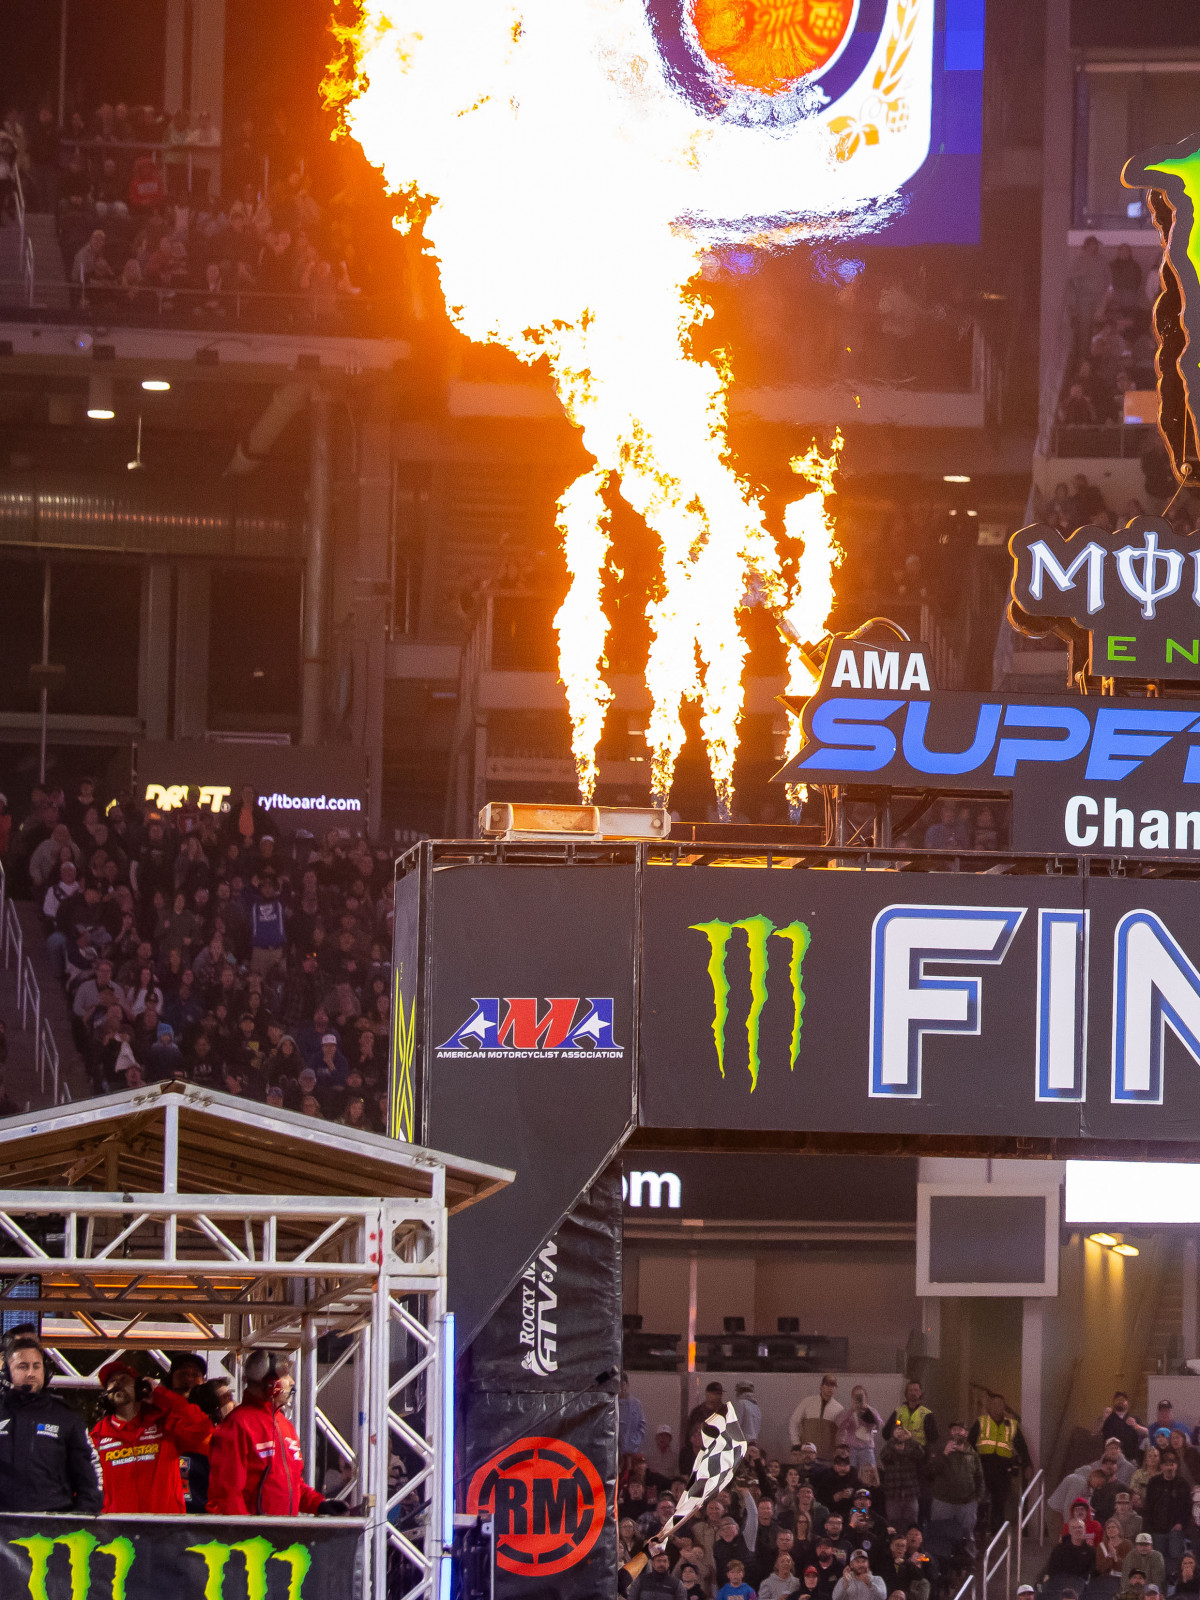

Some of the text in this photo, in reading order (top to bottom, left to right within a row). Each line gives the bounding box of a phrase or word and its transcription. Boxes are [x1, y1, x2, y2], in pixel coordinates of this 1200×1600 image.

[831, 650, 931, 692] AMA
[258, 793, 361, 811] ryftboard.com
[435, 997, 624, 1050] AMA
[436, 1051, 624, 1059] AMERICAN MOTORCYCLIST ASSOCIATION
[519, 1284, 536, 1348] ROCKY
[494, 1478, 578, 1535] RM
